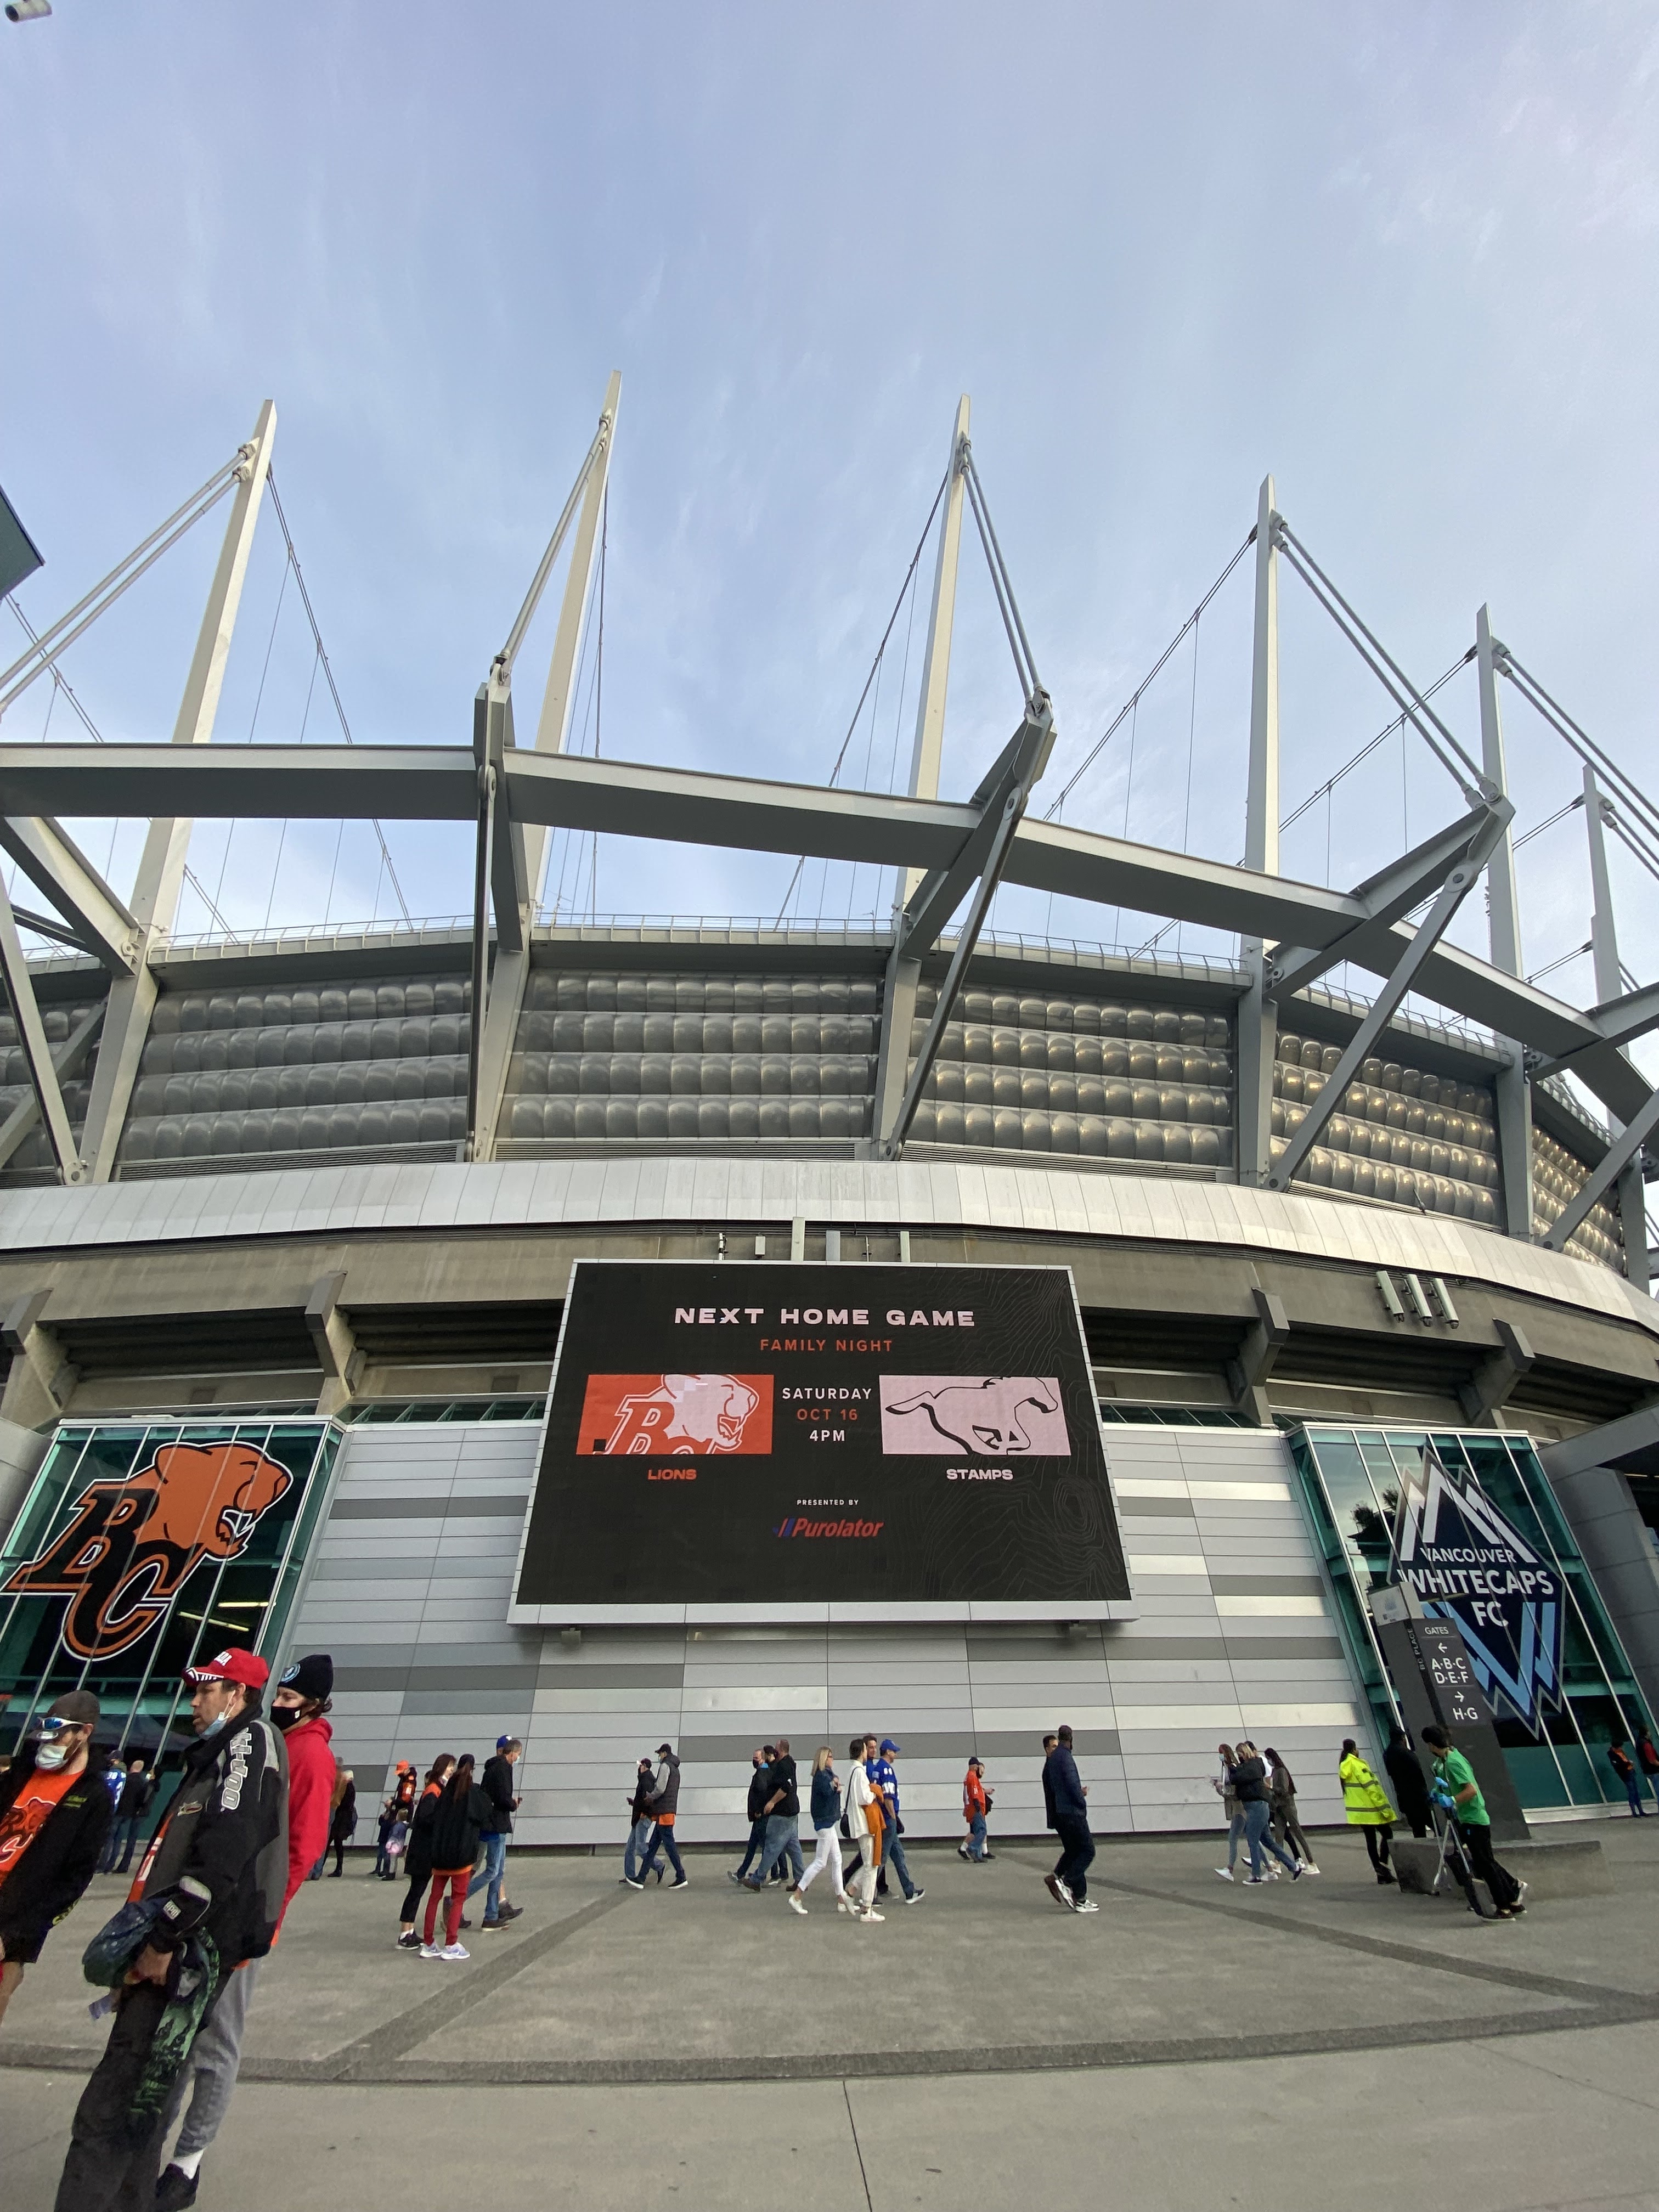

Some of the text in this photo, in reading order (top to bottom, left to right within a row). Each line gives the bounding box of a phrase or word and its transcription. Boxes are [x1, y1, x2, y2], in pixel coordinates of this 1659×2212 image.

[674, 1307, 975, 1327] NEXT HOME GAME
[760, 1339, 892, 1352] FAMILY NIGHT
[782, 1387, 872, 1400] SATURDAY
[797, 1408, 858, 1421] OCT 16
[809, 1430, 845, 1442] 4PM
[647, 1469, 697, 1480] LIONS
[946, 1469, 1013, 1480] STAMPS
[792, 1517, 884, 1538] Purolator
[1420, 1547, 1517, 1563] VANCOUVER
[1397, 1568, 1554, 1595] WHITECAPS
[1471, 1601, 1509, 1627] FC
[1424, 1627, 1449, 1635] GATES
